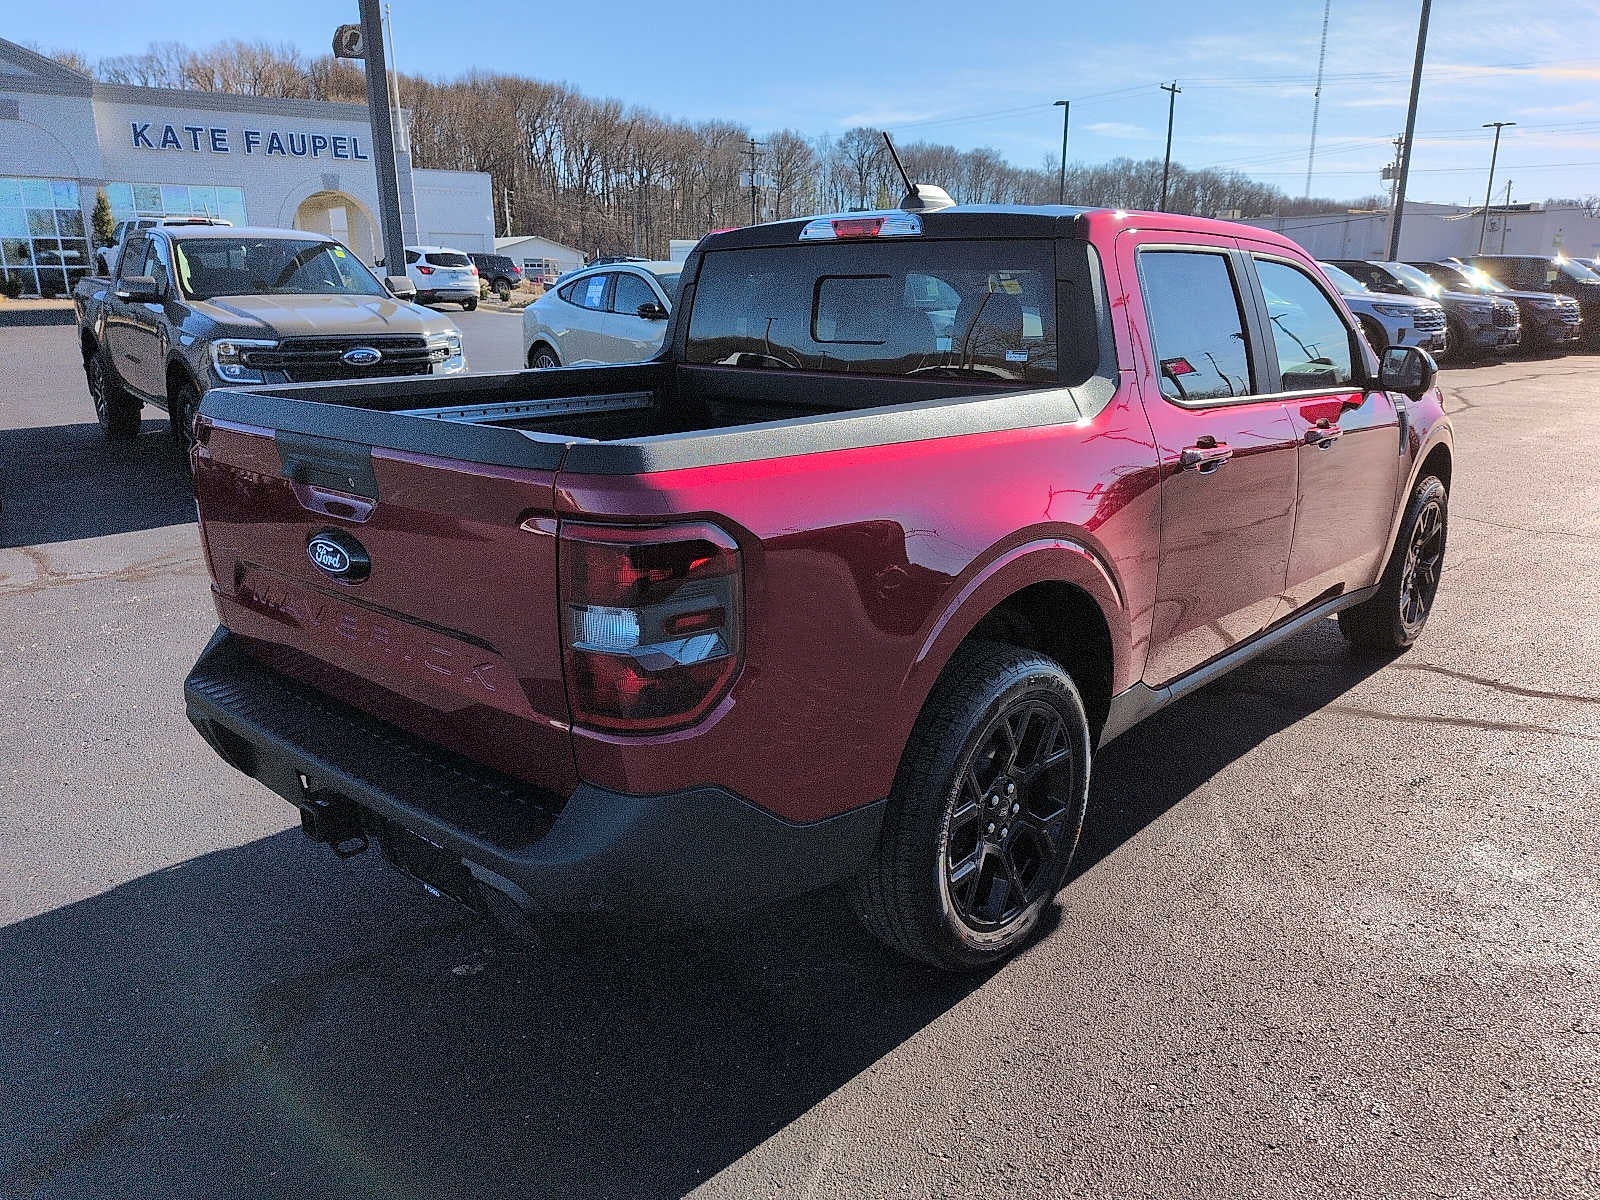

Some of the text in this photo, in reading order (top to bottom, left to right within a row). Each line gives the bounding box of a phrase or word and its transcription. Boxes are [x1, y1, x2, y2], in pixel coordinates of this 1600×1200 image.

[131, 121, 369, 161] KATE FAUPEL
[315, 543, 341, 568] Ford
